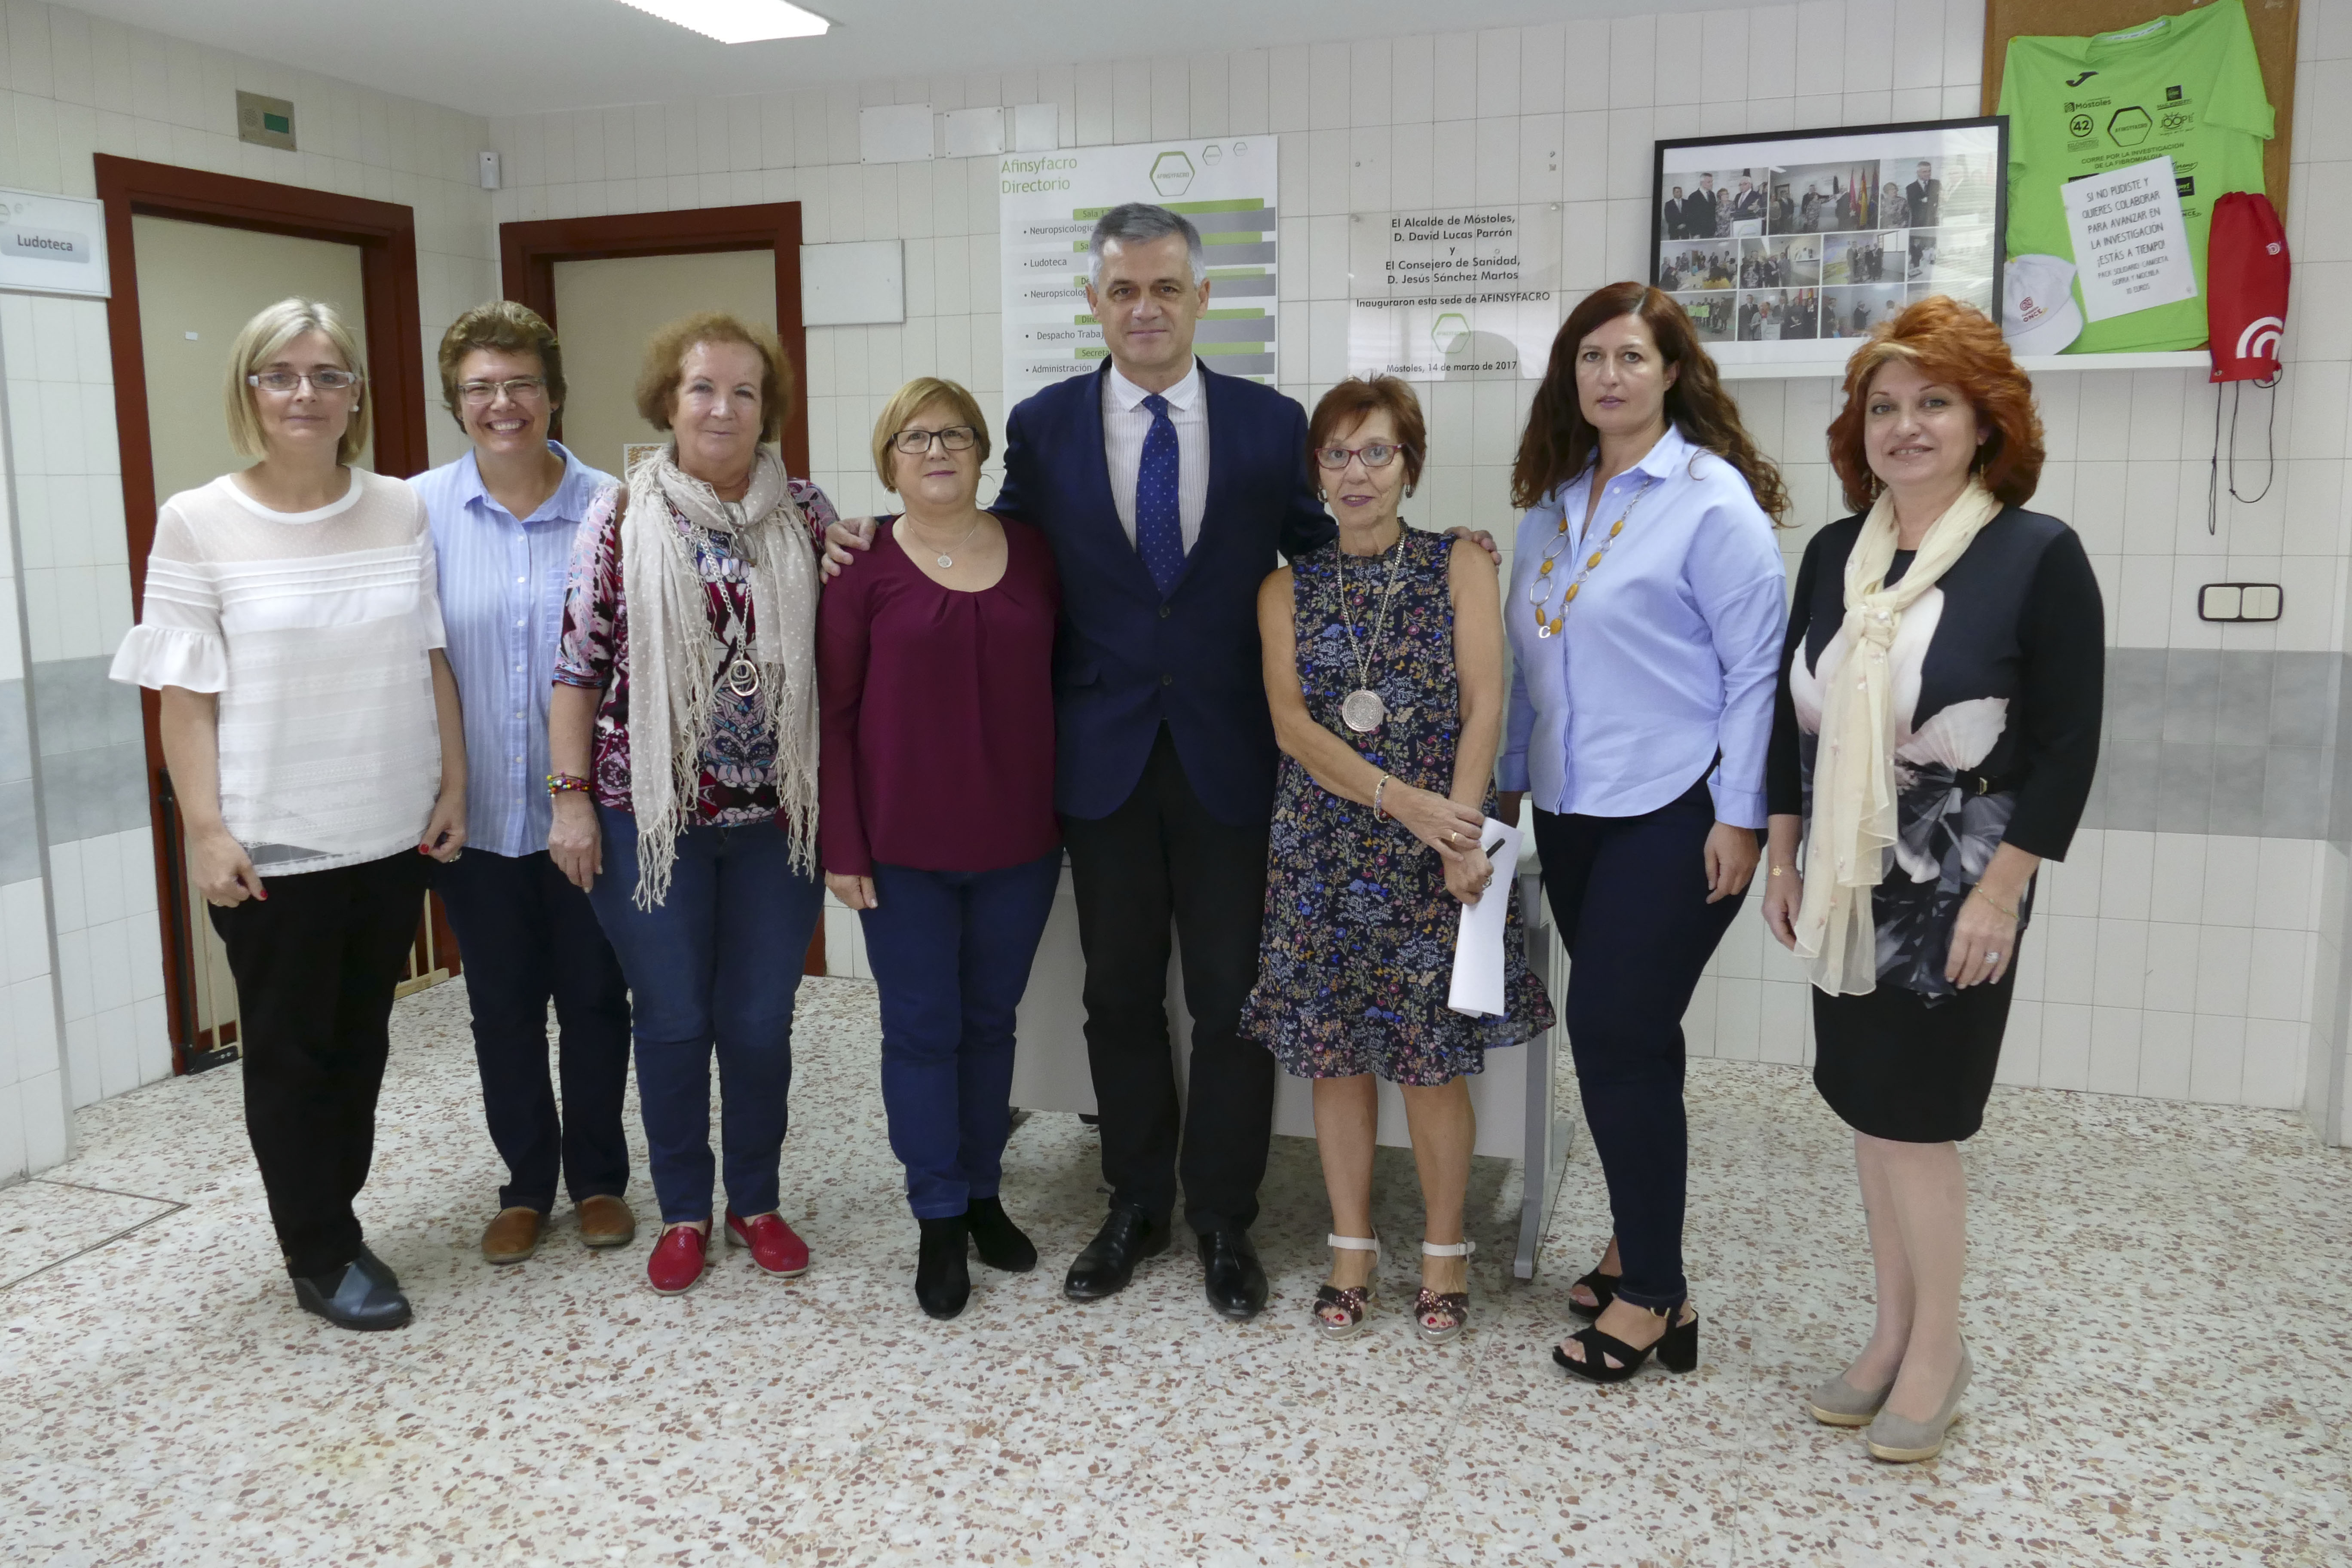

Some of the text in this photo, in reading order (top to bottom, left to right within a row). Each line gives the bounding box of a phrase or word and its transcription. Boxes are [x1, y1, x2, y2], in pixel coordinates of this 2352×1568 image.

[2073, 120, 2090, 131] 42
[1001, 157, 1077, 175] Afinsyfacro
[2082, 156, 2104, 164] CORRE
[1002, 177, 1070, 193] Directorio
[2087, 178, 2148, 202] SI NO PUDISTE Y
[2082, 190, 2161, 219] QUIERES COLABORAR
[1392, 213, 1515, 228] El Alcalde de Móstoles,
[2088, 207, 2161, 234] PARA AVANZAR EN
[1394, 227, 1513, 242] D. David Lucas Parrón
[2091, 221, 2164, 249] LA INVESTIGACIÓN
[17, 234, 73, 251] Ludoteca
[1449, 246, 1455, 255] y
[2097, 239, 2165, 268] ¡ESTÁS A TIEMPO!
[1030, 259, 1067, 267] Ludoteca
[1386, 256, 1520, 270] El Consejero de Sanidad,
[1387, 271, 1519, 284] D. Jesús Sánchez Martos
[2112, 276, 2129, 286] GORRA
[2136, 269, 2160, 279] MOCHILA
[1357, 292, 1550, 309] Inauguraron esta sede de AFINSYFACRO
[2023, 309, 2043, 322] ONCE
[1037, 330, 1104, 340] Despacho Trabaj
[1032, 364, 1092, 374] Administración
[1386, 364, 1425, 374] Móstoles,
[1428, 363, 1438, 372] 14
[1440, 362, 1451, 371] de
[1482, 361, 1493, 370] de
[1496, 361, 1517, 370] 2017
